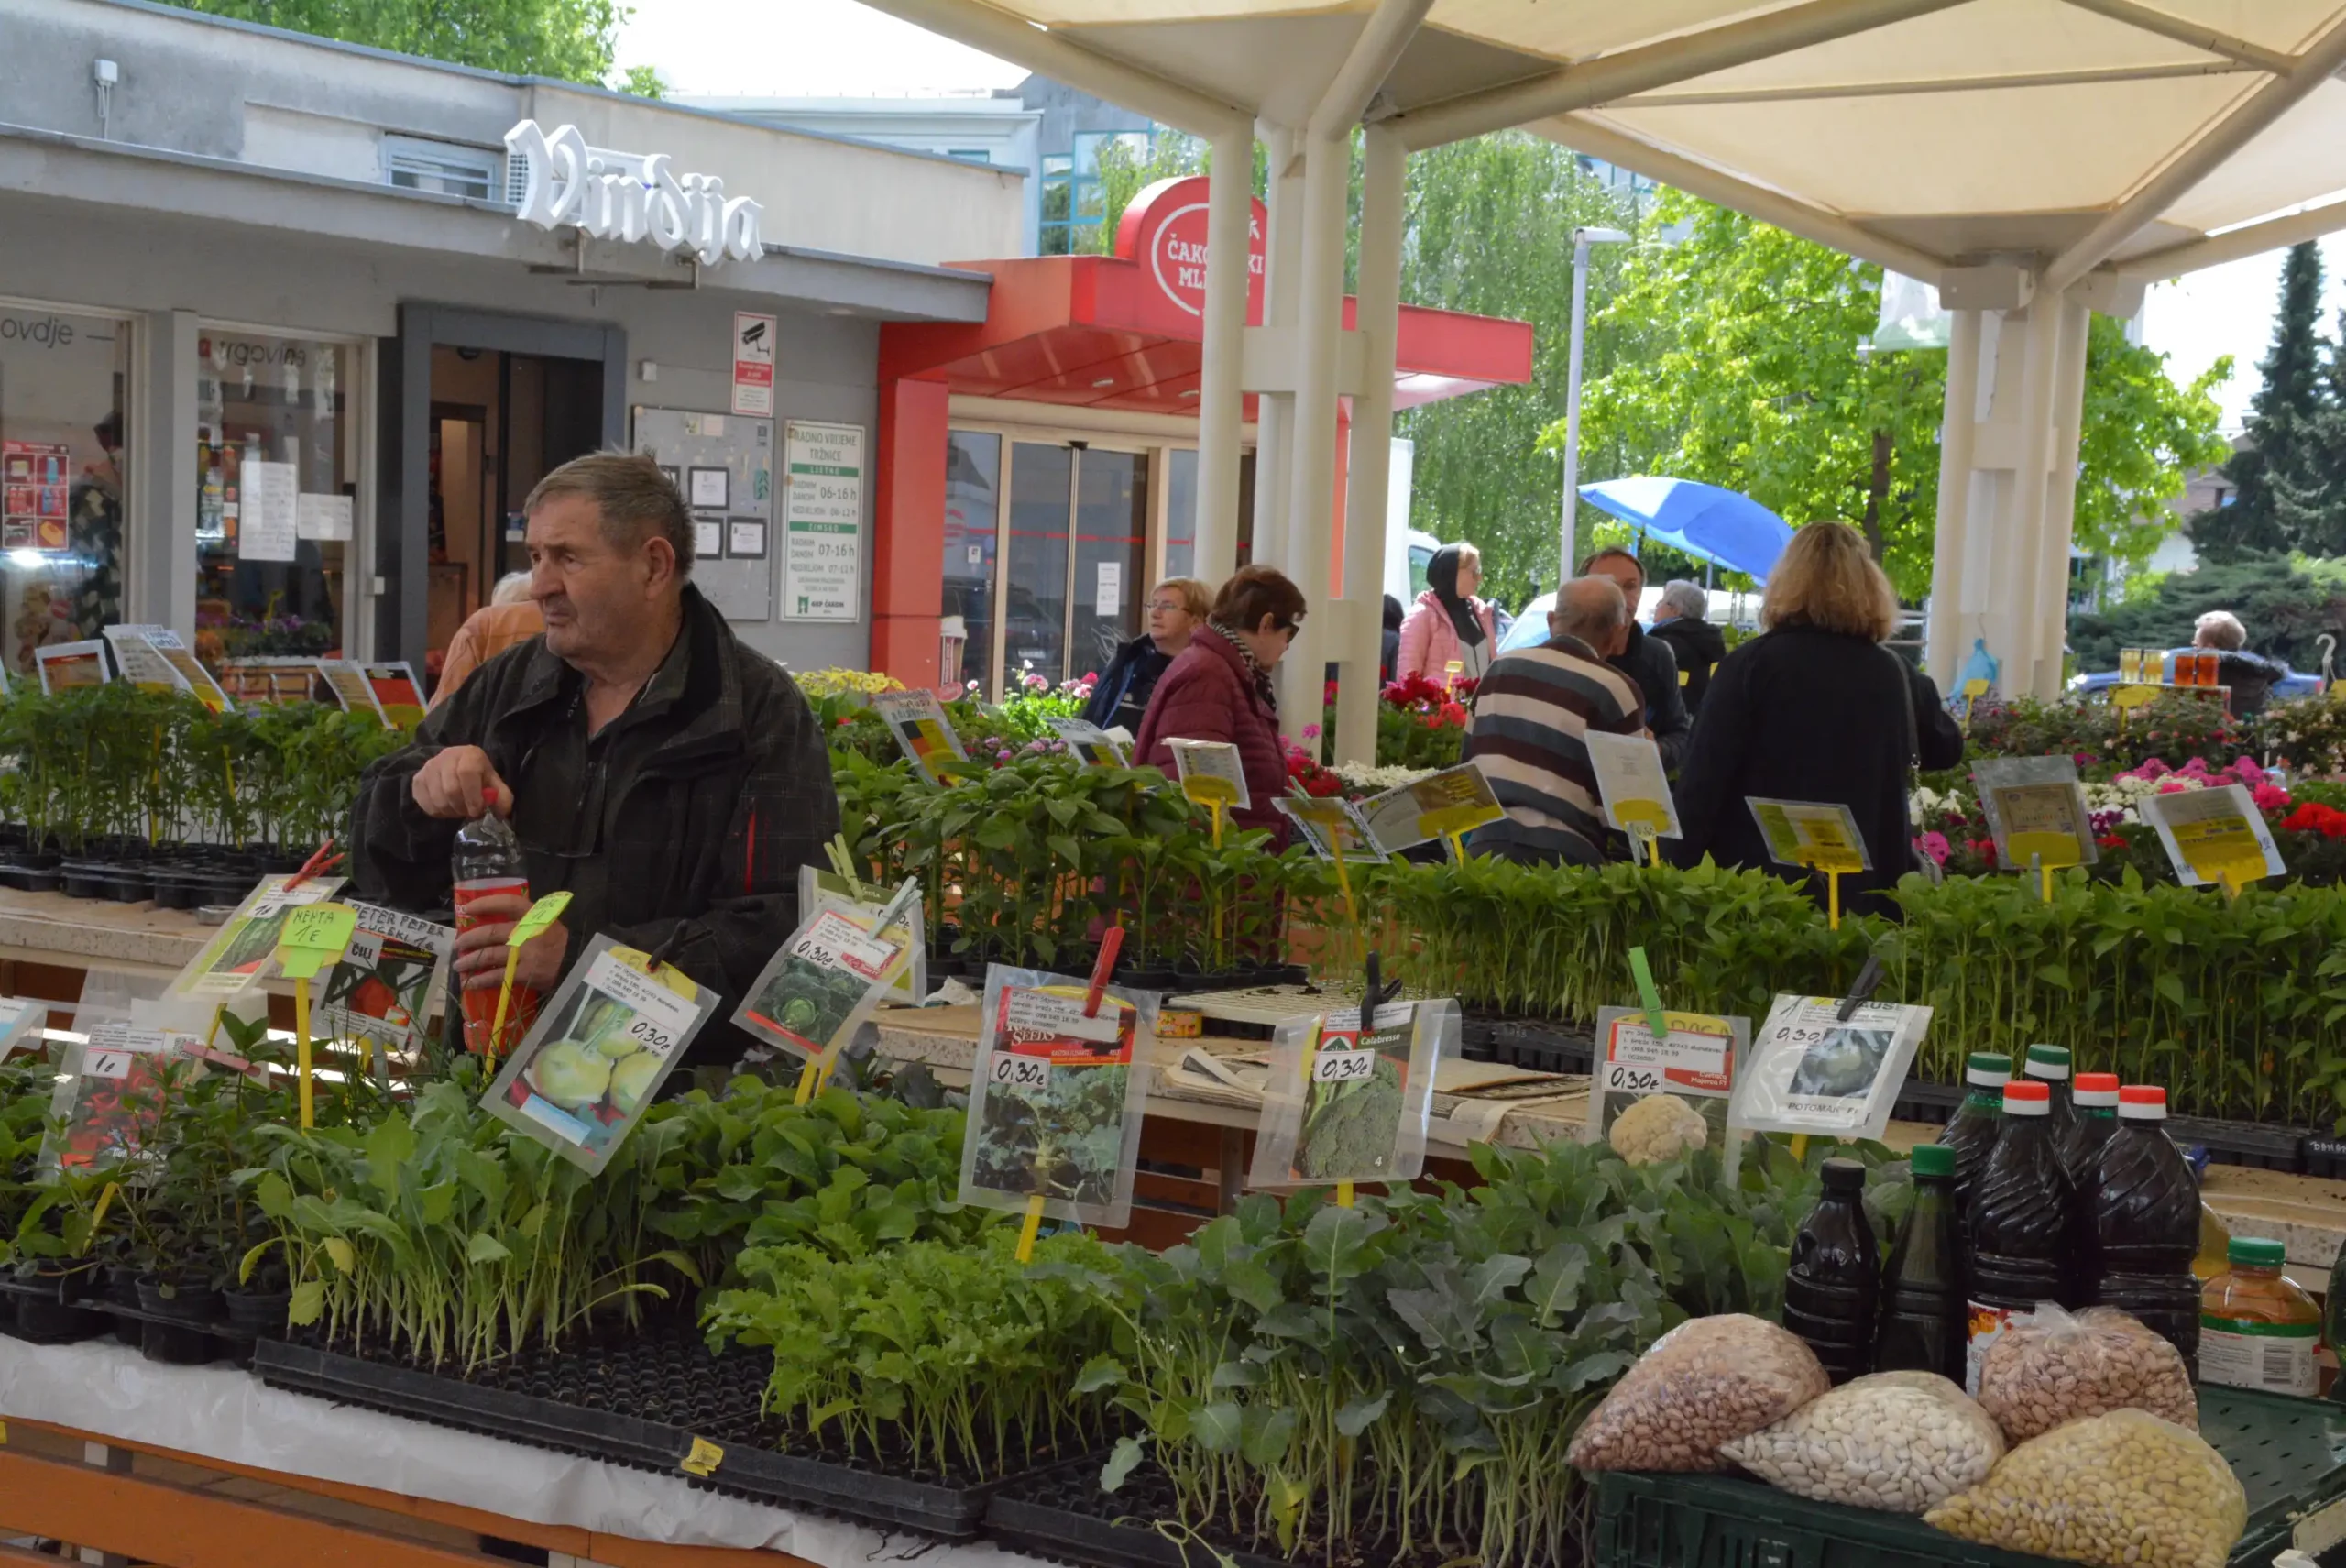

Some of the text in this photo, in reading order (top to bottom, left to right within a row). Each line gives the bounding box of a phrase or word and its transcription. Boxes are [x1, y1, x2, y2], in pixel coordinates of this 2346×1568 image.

[504, 119, 765, 266] Vindija
[1, 316, 73, 349] ovdje
[825, 433, 858, 446] VRIJEME
[810, 446, 842, 461] TRŽNICE
[820, 486, 849, 500] 06-16
[818, 543, 847, 557] 07-16
[351, 903, 445, 938] PETER PEPER
[1360, 1033, 1401, 1046] Calabresse
[1374, 1156, 1383, 1167] 4
